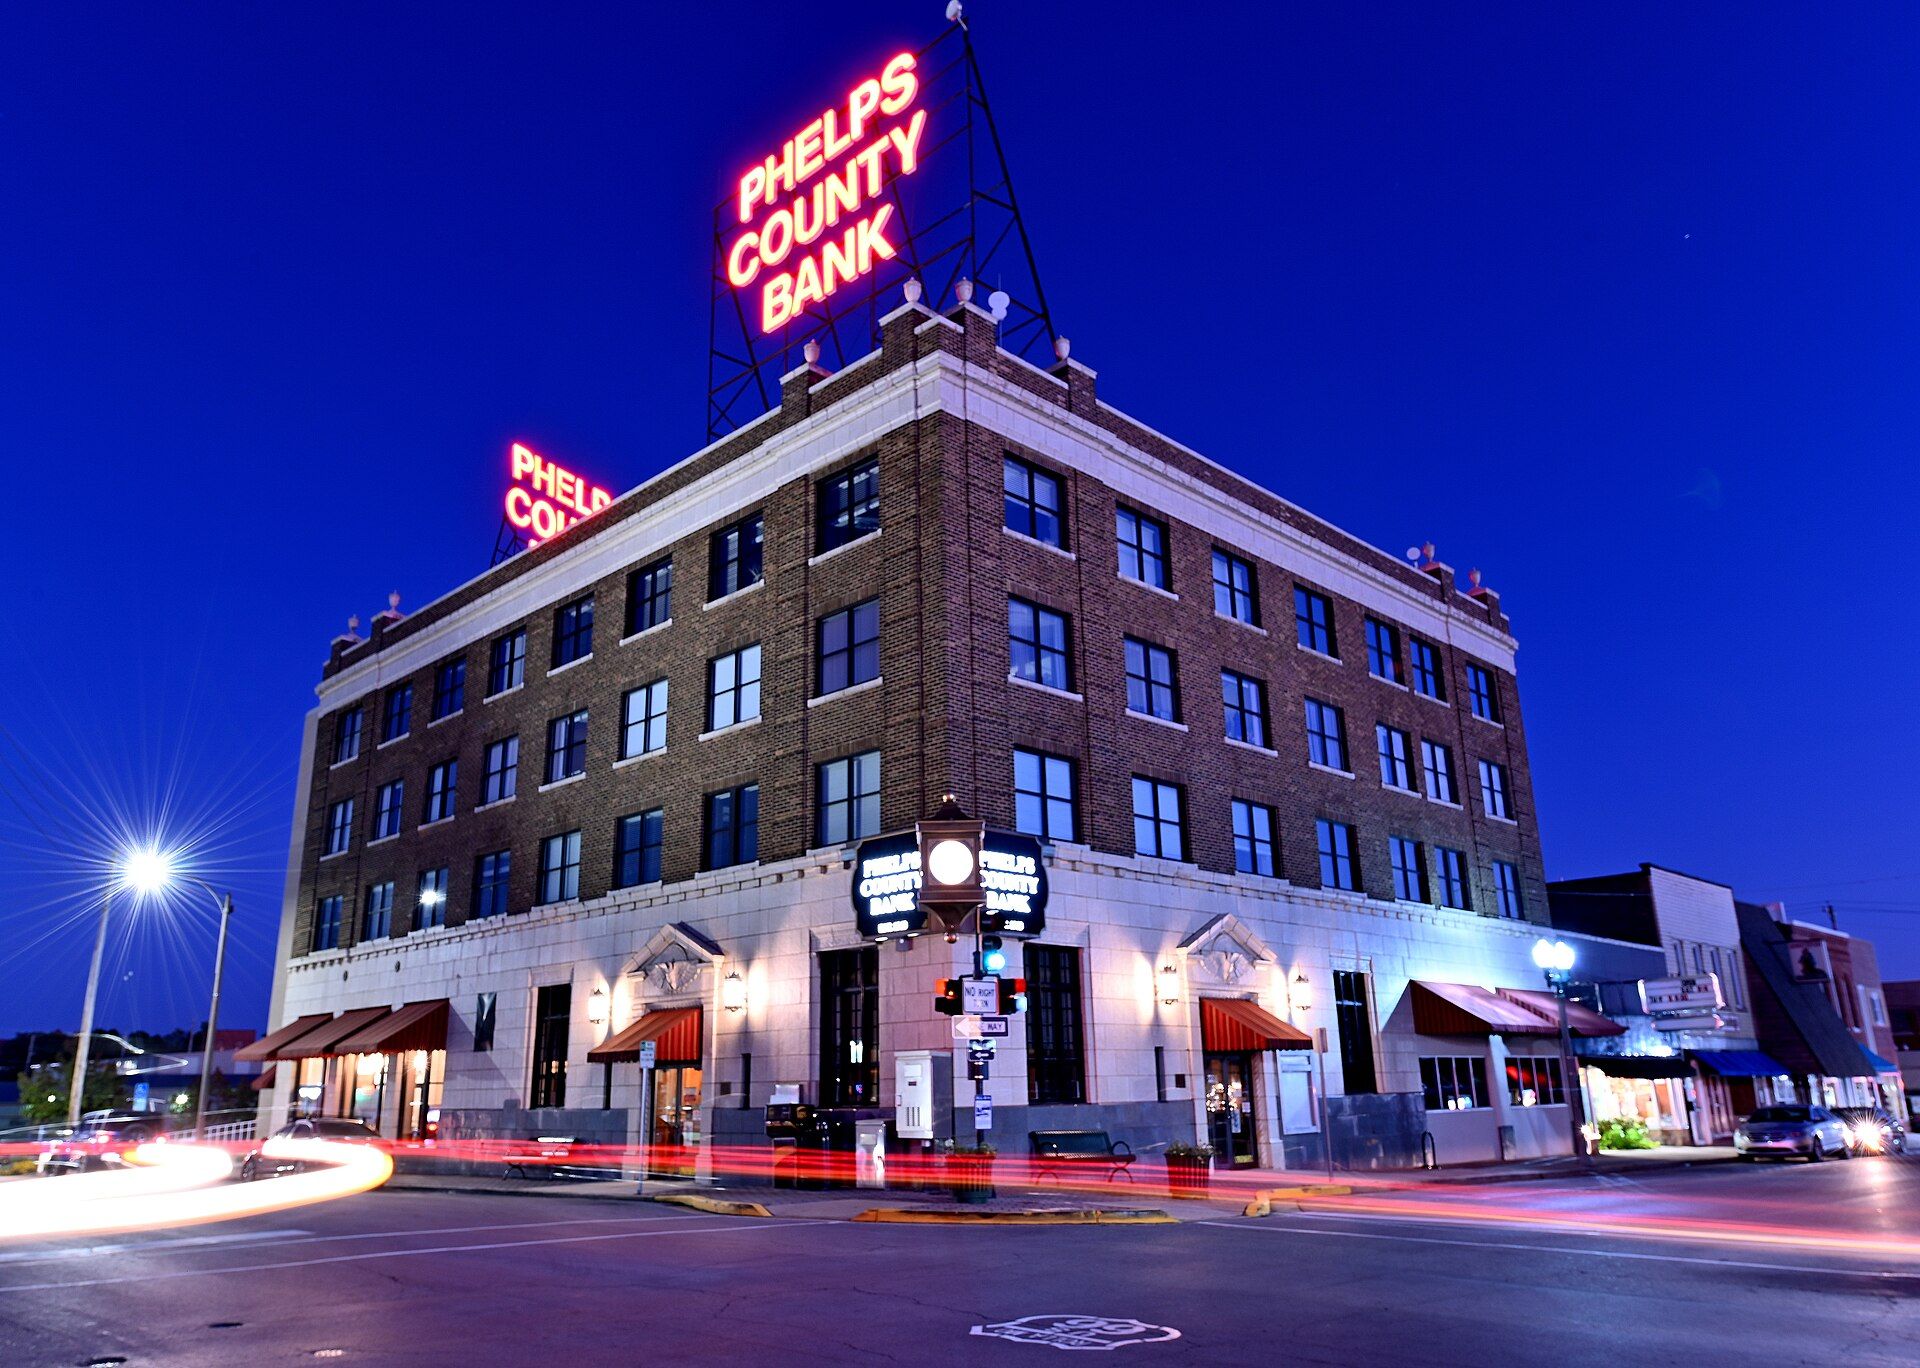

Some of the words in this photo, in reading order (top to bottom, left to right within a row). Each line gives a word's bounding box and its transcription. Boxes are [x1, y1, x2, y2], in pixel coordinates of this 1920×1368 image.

[739, 52, 918, 223] PHELPS
[728, 109, 927, 287] COUNTY
[762, 203, 896, 334] BANK
[869, 891, 916, 916] BANK
[986, 890, 1031, 914] BANK
[964, 986, 976, 997] NO
[978, 988, 995, 997] RIGHT
[987, 1022, 1003, 1031] WAY
